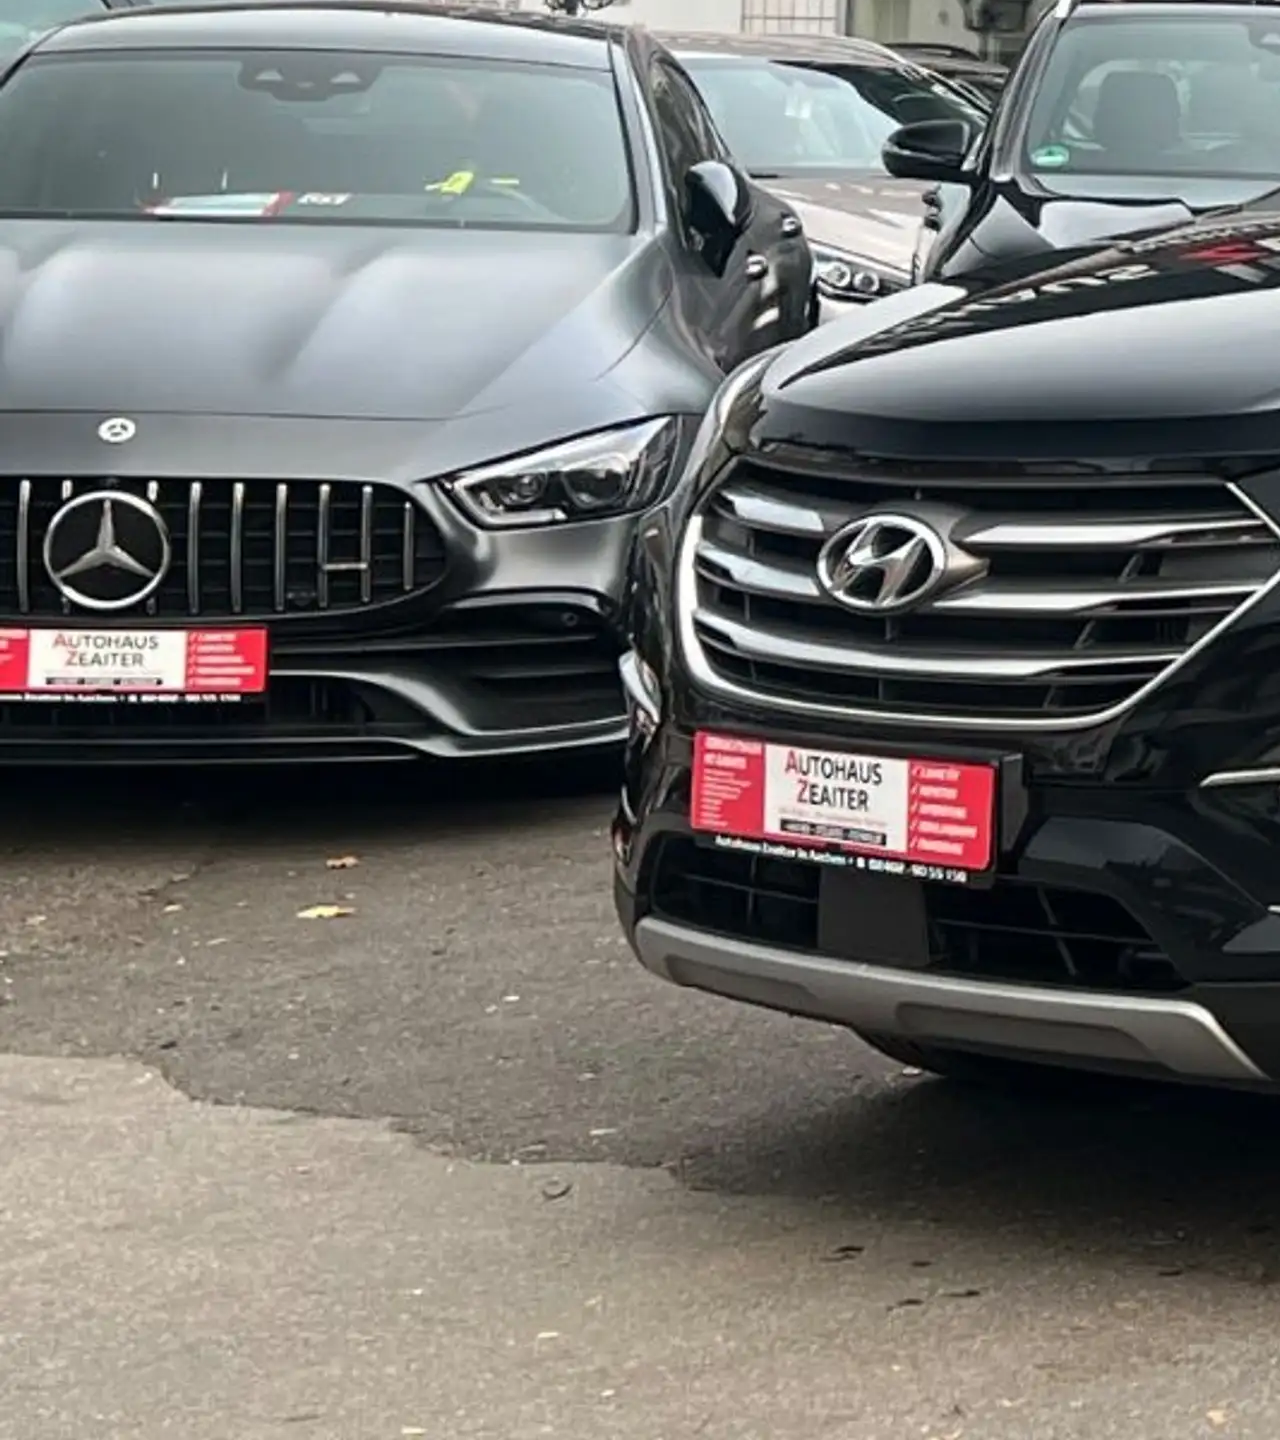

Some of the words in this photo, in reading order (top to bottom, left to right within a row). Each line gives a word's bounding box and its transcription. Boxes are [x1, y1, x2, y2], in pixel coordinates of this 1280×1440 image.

[51, 633, 159, 650] AUTOHAUS
[64, 650, 145, 668] ZEAITER
[785, 749, 883, 786] AUTOHAUS
[796, 780, 869, 812] ZEAITER
